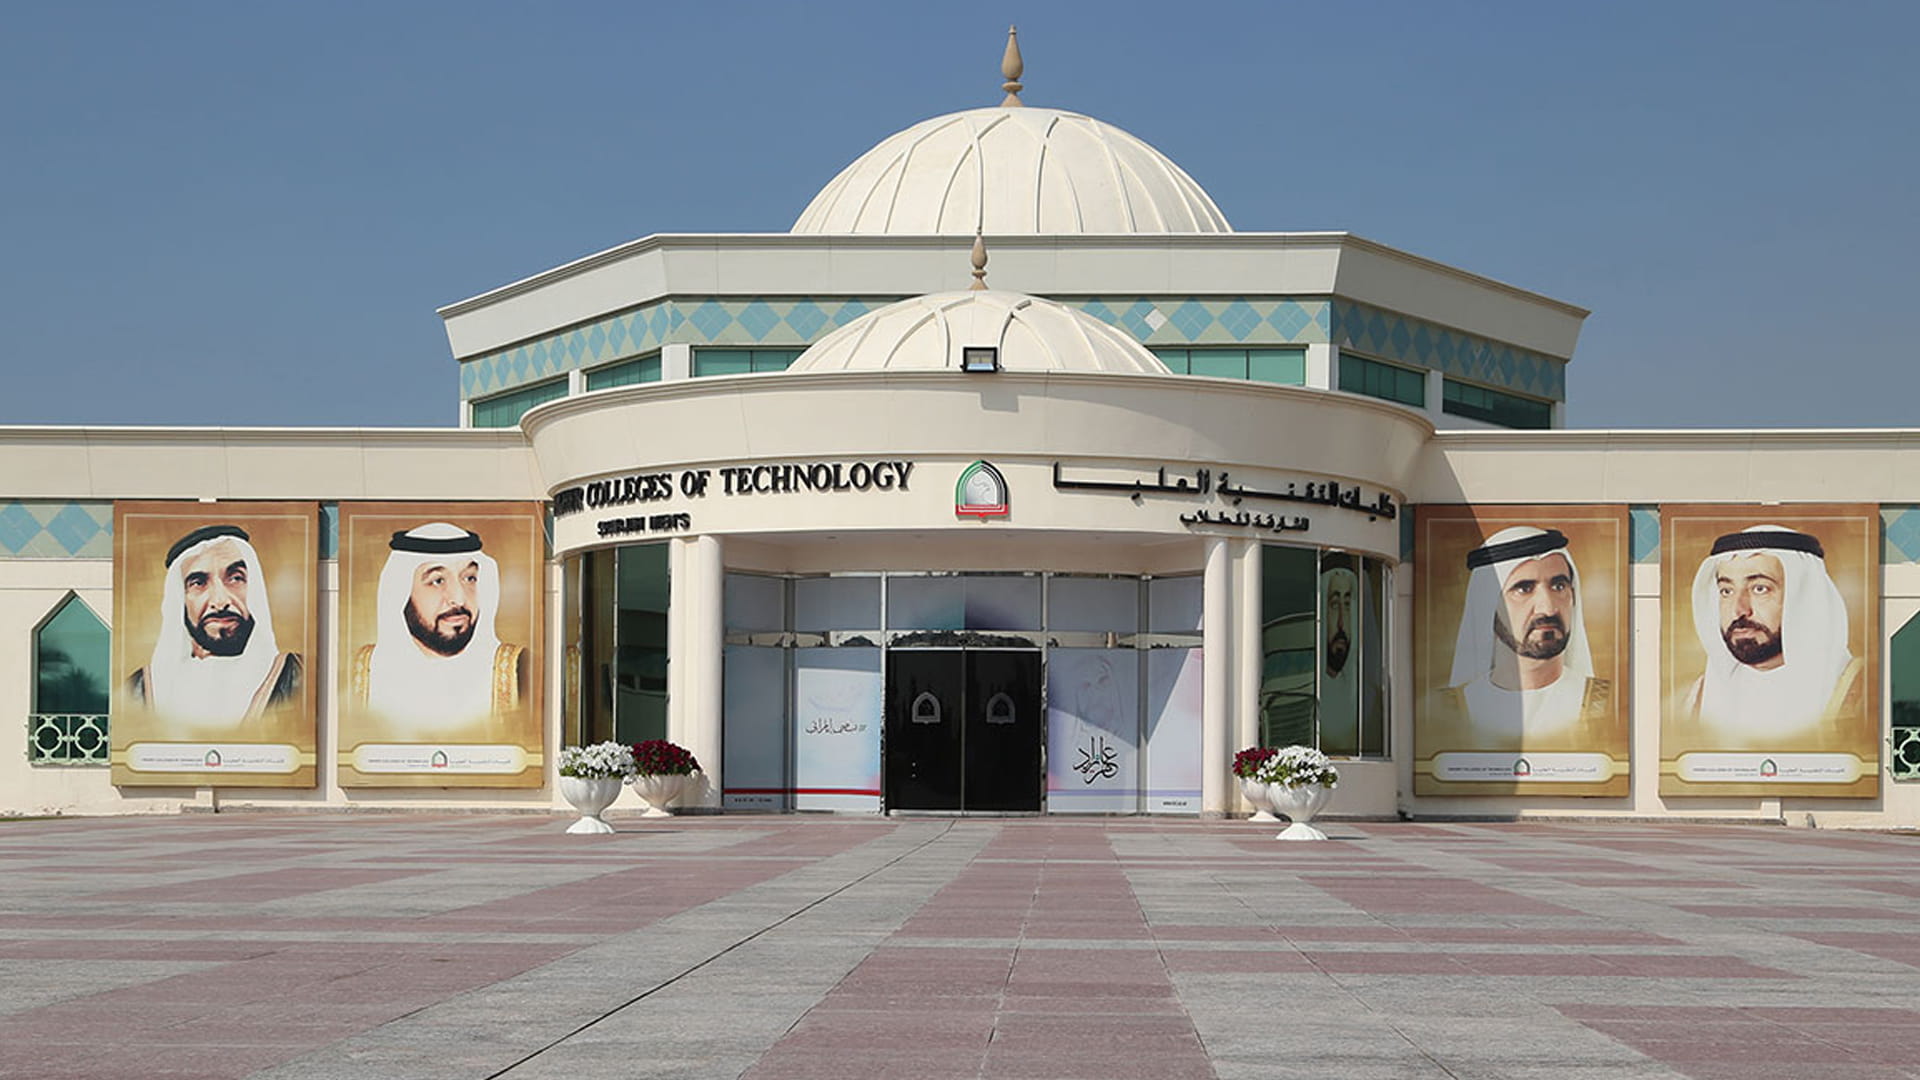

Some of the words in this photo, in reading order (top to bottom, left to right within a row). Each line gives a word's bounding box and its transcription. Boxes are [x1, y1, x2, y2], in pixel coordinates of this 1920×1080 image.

[586, 473, 673, 508] COLLEGES
[680, 470, 711, 498] OF
[720, 461, 914, 495] TECHNOLOGY
[1053, 461, 1210, 501] العليا
[1216, 472, 1340, 507] التقنية
[1179, 509, 1250, 527] للطلاب
[1339, 486, 1397, 522] كليات
[1252, 513, 1310, 533] الشارقة
